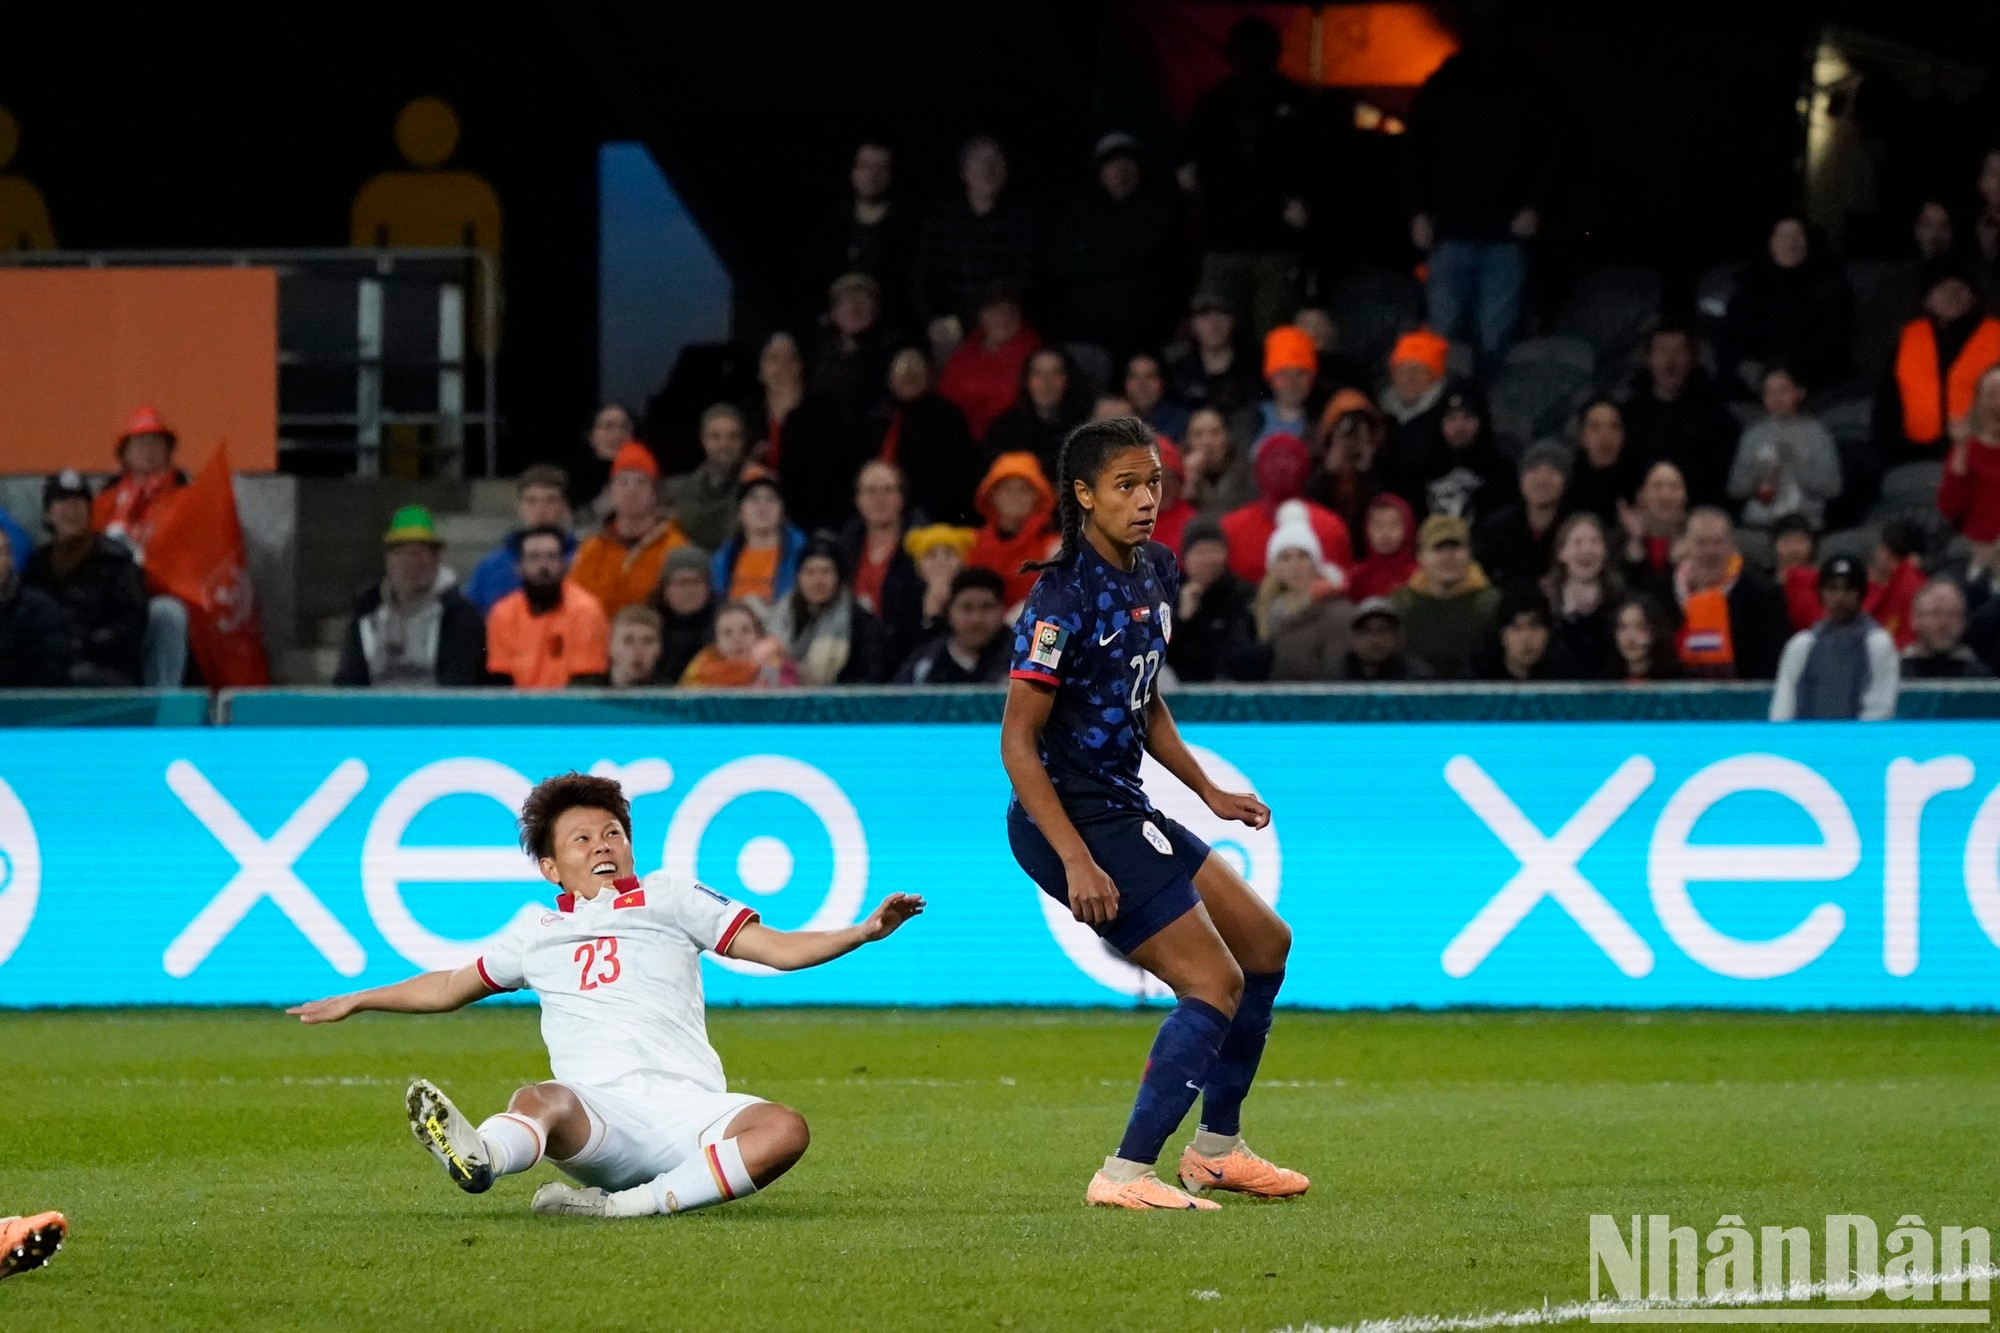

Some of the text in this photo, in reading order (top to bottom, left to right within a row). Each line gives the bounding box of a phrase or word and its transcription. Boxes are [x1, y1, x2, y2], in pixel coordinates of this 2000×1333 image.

[1130, 649, 1160, 712] 22
[1442, 753, 2000, 979] xer
[573, 936, 621, 991] 23
